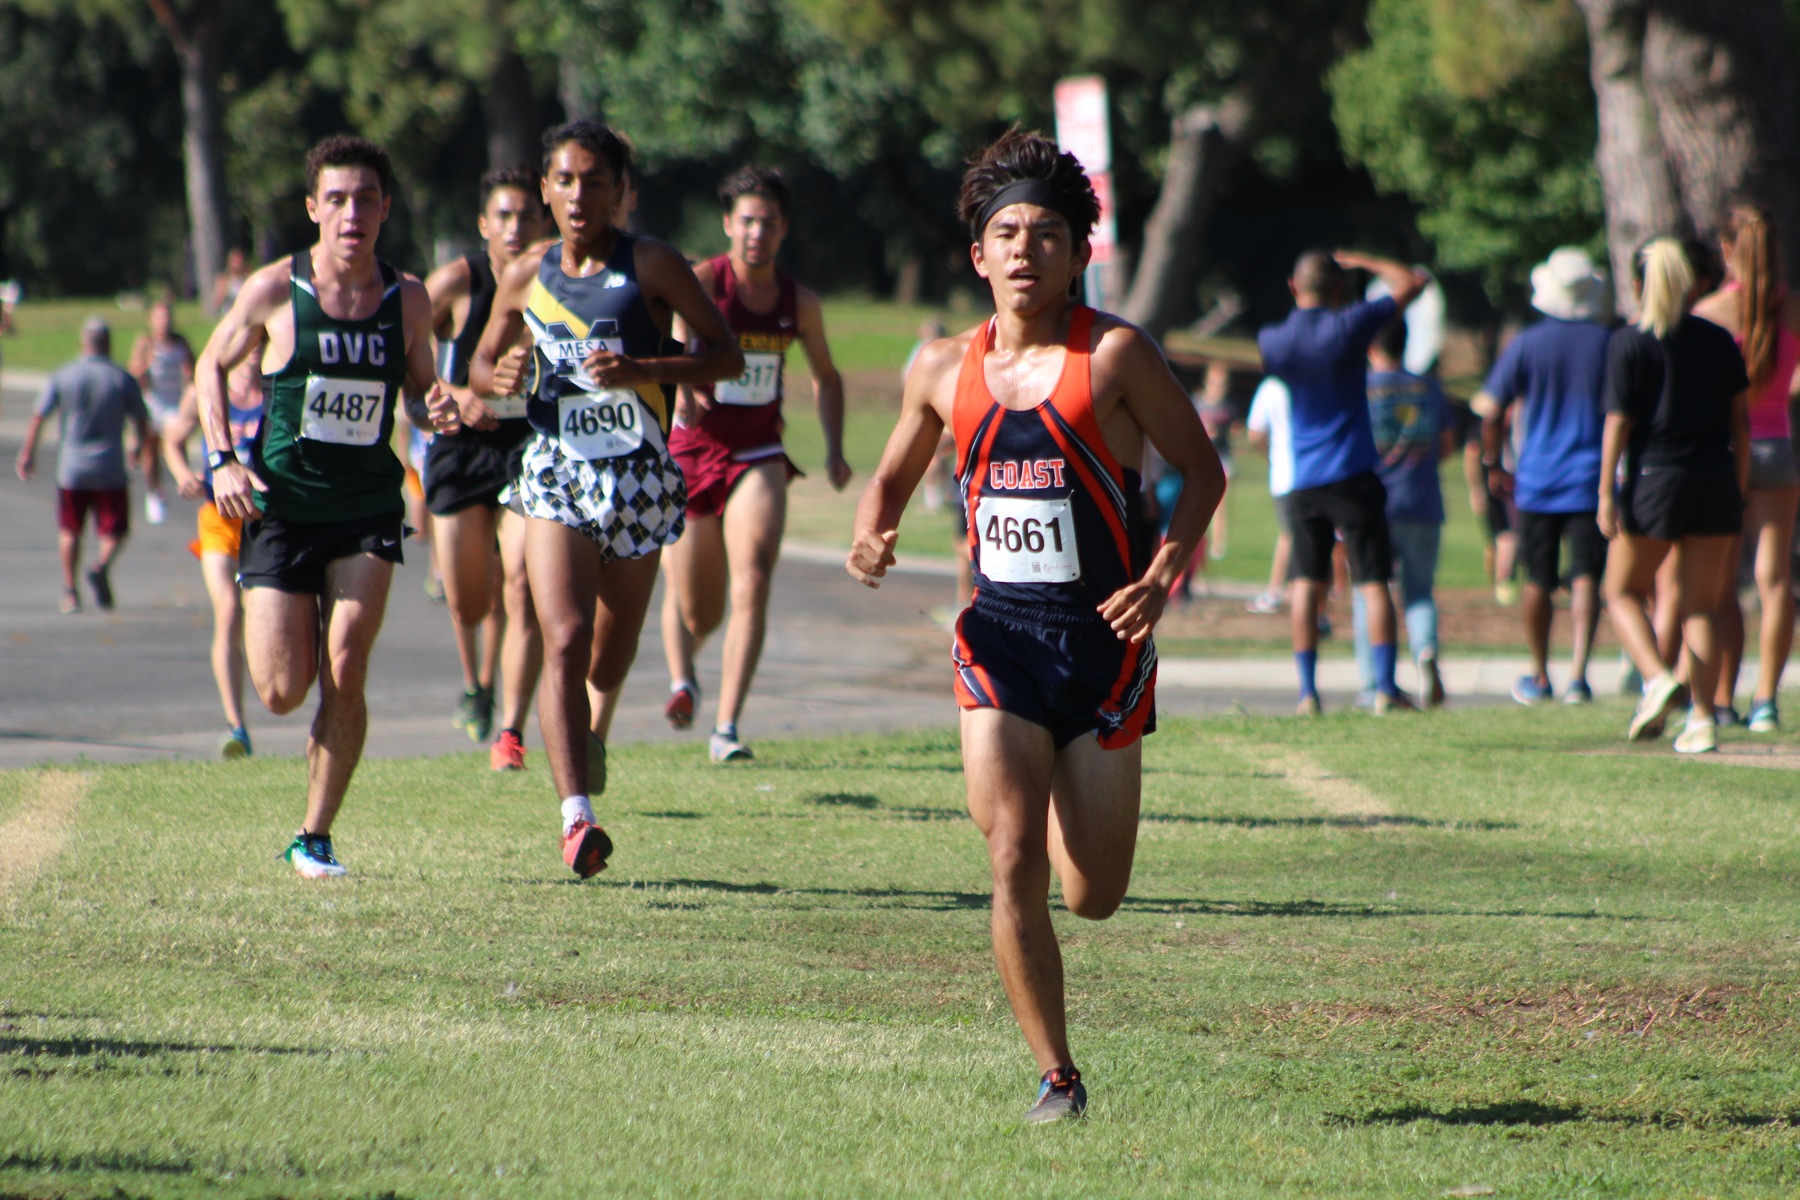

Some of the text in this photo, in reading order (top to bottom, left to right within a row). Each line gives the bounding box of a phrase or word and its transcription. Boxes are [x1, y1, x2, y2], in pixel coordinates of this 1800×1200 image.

[318, 332, 385, 366] DVC
[559, 341, 610, 358] MESA
[729, 364, 774, 387] 517
[309, 391, 381, 423] 4487
[564, 402, 635, 438] 4690
[990, 459, 1064, 490] COAST
[985, 515, 1063, 553] 4661
